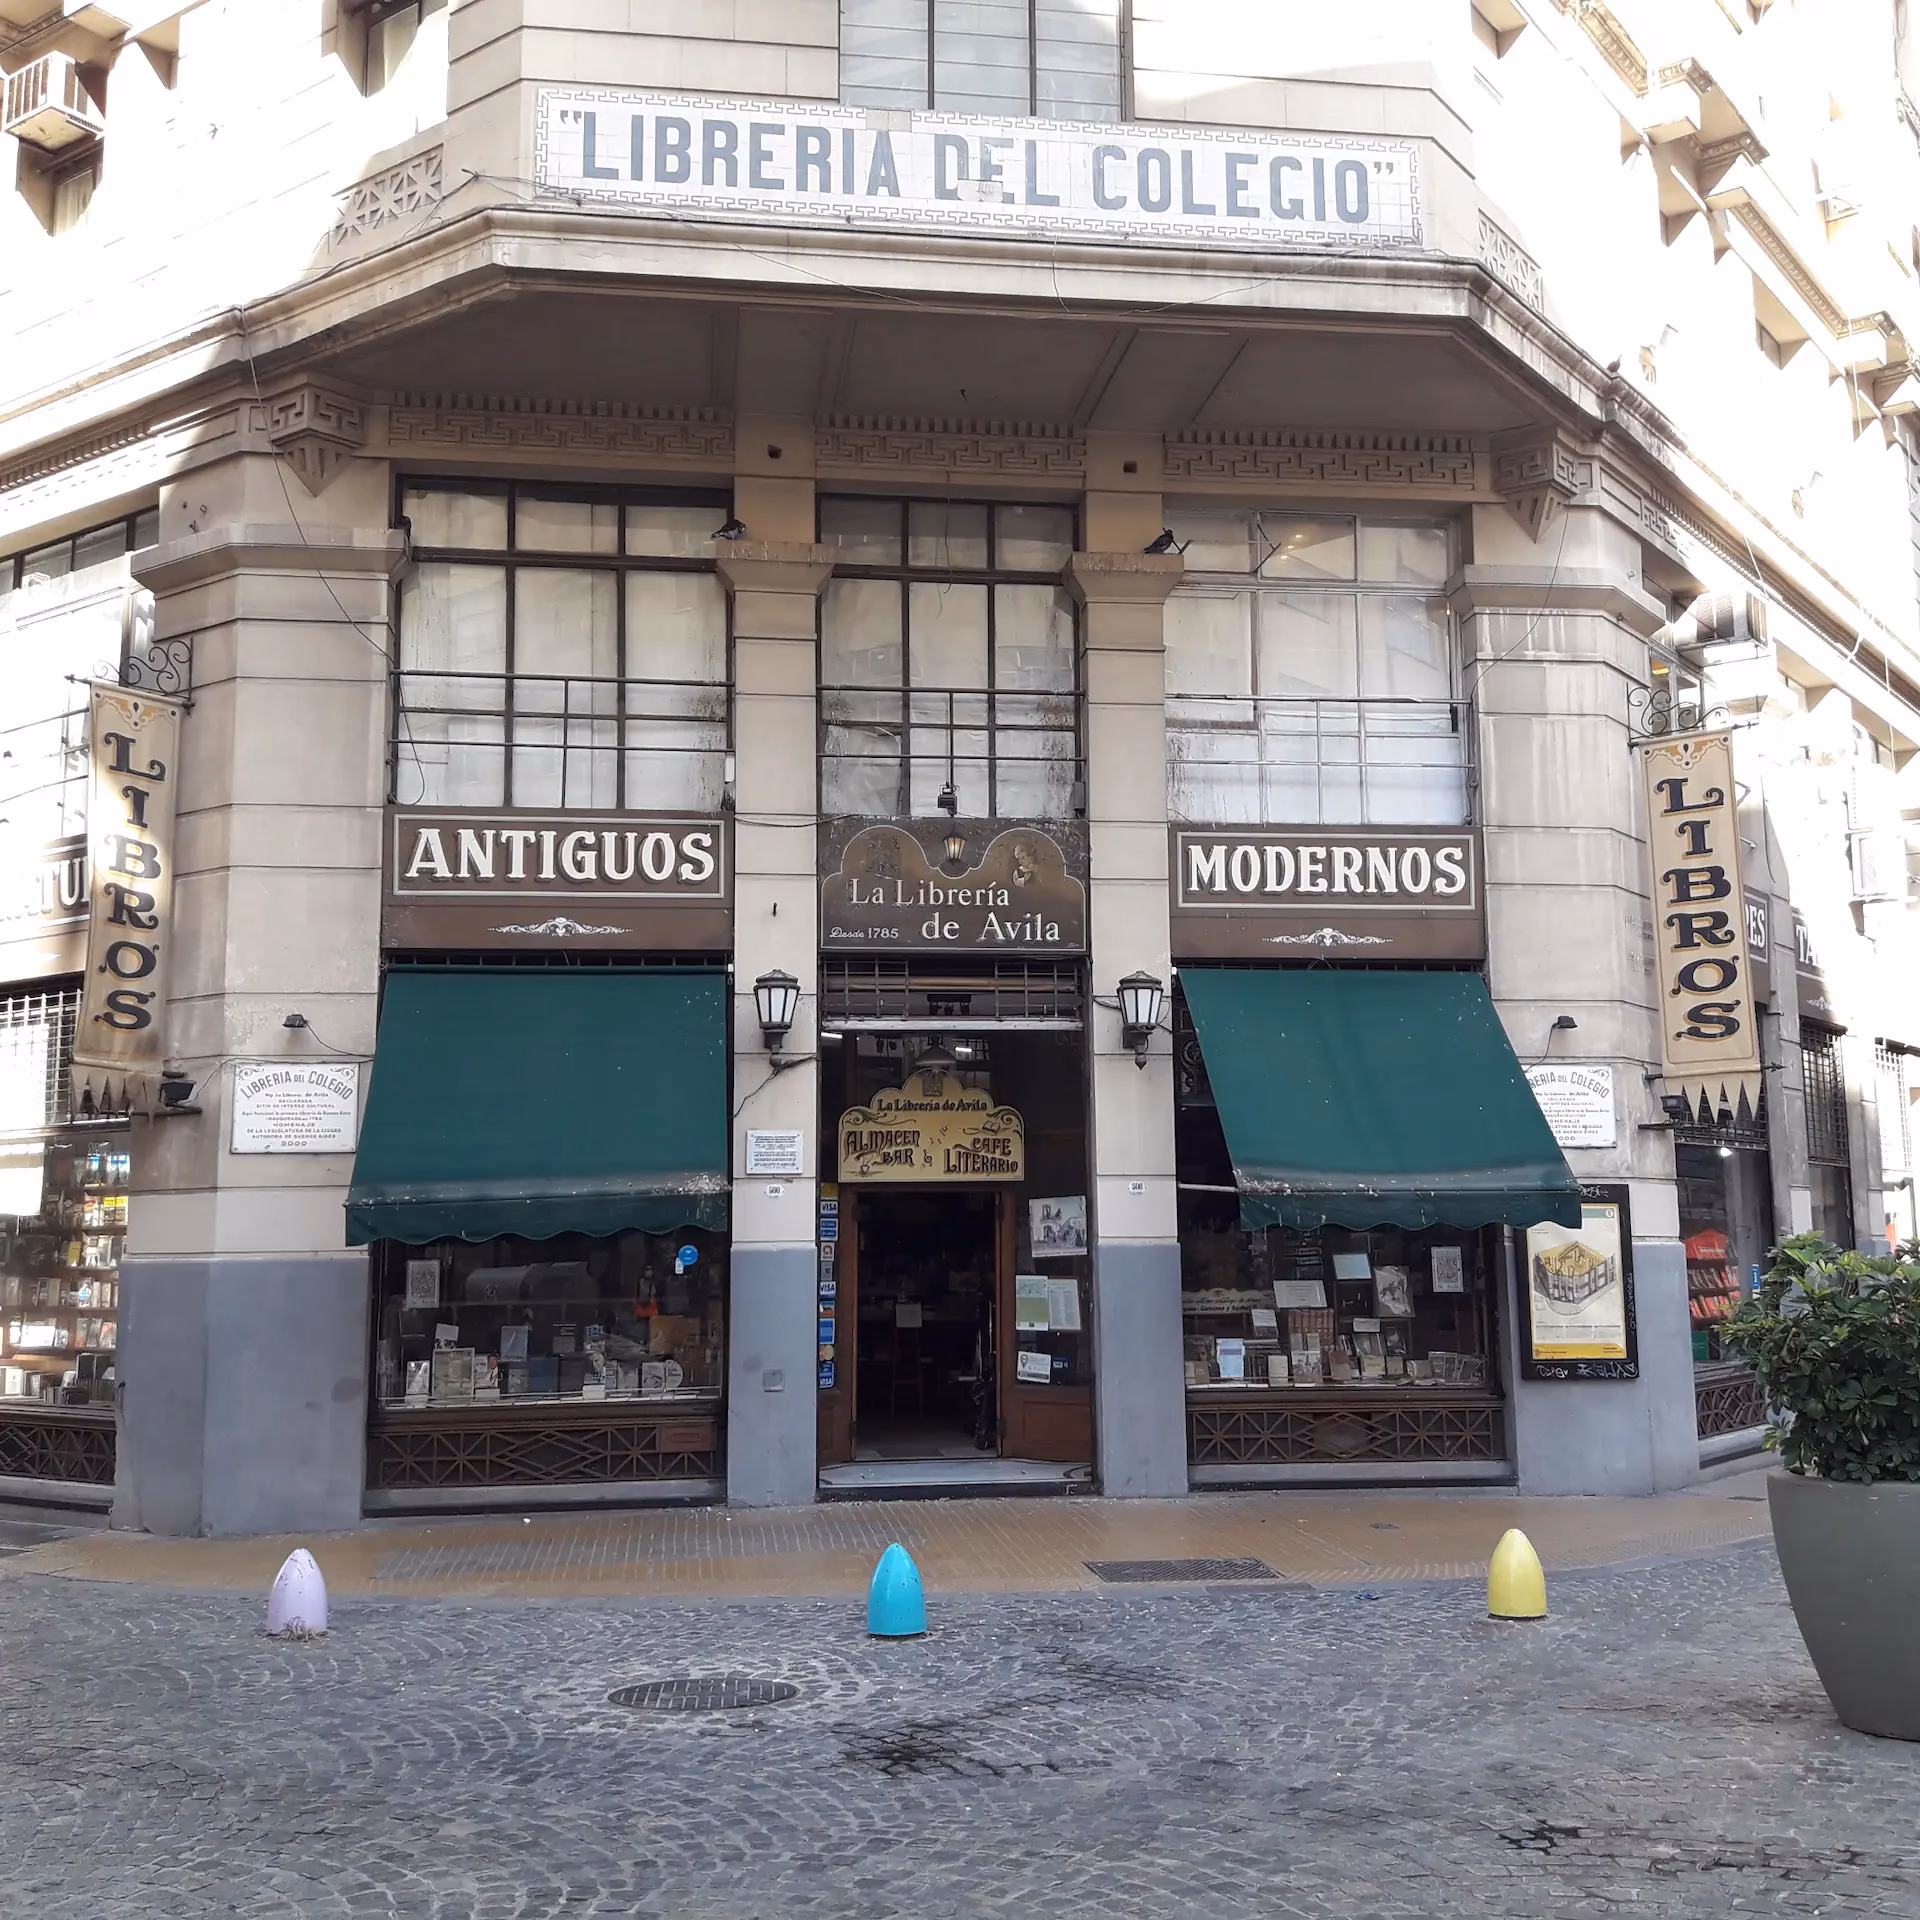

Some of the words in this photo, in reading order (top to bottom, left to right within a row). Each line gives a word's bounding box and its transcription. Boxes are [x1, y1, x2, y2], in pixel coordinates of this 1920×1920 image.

[935, 132, 1060, 207] DEL
[404, 827, 716, 883] ANTIGUOS
[94, 731, 167, 1030] LIBROS
[1187, 844, 1467, 896] MODERNOS
[850, 878, 884, 904] La
[895, 879, 1010, 906] Librería
[1656, 776, 1741, 1039] LIBROS
[828, 926, 865, 939] Desde
[867, 927, 899, 939] 1785
[921, 911, 960, 940] de
[980, 911, 1061, 941] Avila
[240, 1070, 292, 1099] LIBRERIA
[294, 1074, 305, 1083] DEL
[308, 1070, 353, 1100] COLEGIO
[1557, 1075, 1567, 1083] DEL
[1571, 1071, 1610, 1099] COLEGIO
[877, 1098, 893, 1112] La
[942, 1098, 955, 1112] de
[844, 1130, 920, 1158] ALMACEN
[877, 1148, 916, 1167] BAR
[971, 1137, 1012, 1156] CAFE
[943, 1148, 1019, 1176] LITERARIO
[821, 1203, 837, 1211] VISA
[820, 1283, 835, 1292] VISA
[820, 1377, 832, 1386] VISA
